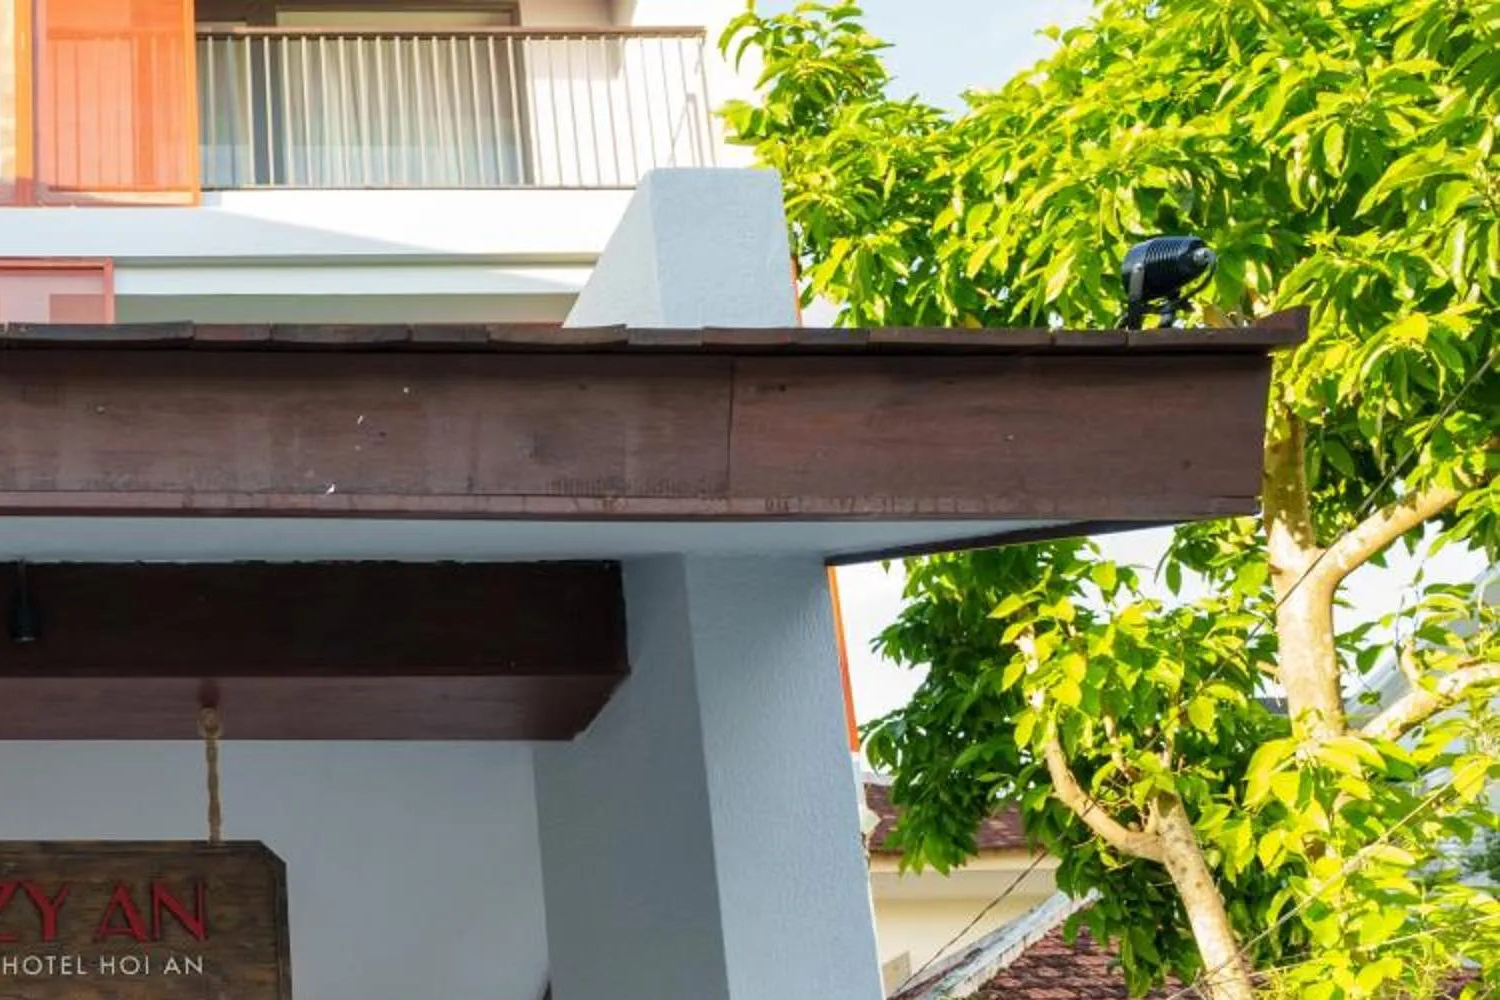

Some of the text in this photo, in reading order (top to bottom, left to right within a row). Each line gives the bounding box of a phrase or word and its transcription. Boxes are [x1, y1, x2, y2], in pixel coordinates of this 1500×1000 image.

[94, 879, 208, 943] AN
[3, 955, 87, 975] HOTEL
[100, 955, 150, 975] HOI
[163, 956, 204, 975] AN
